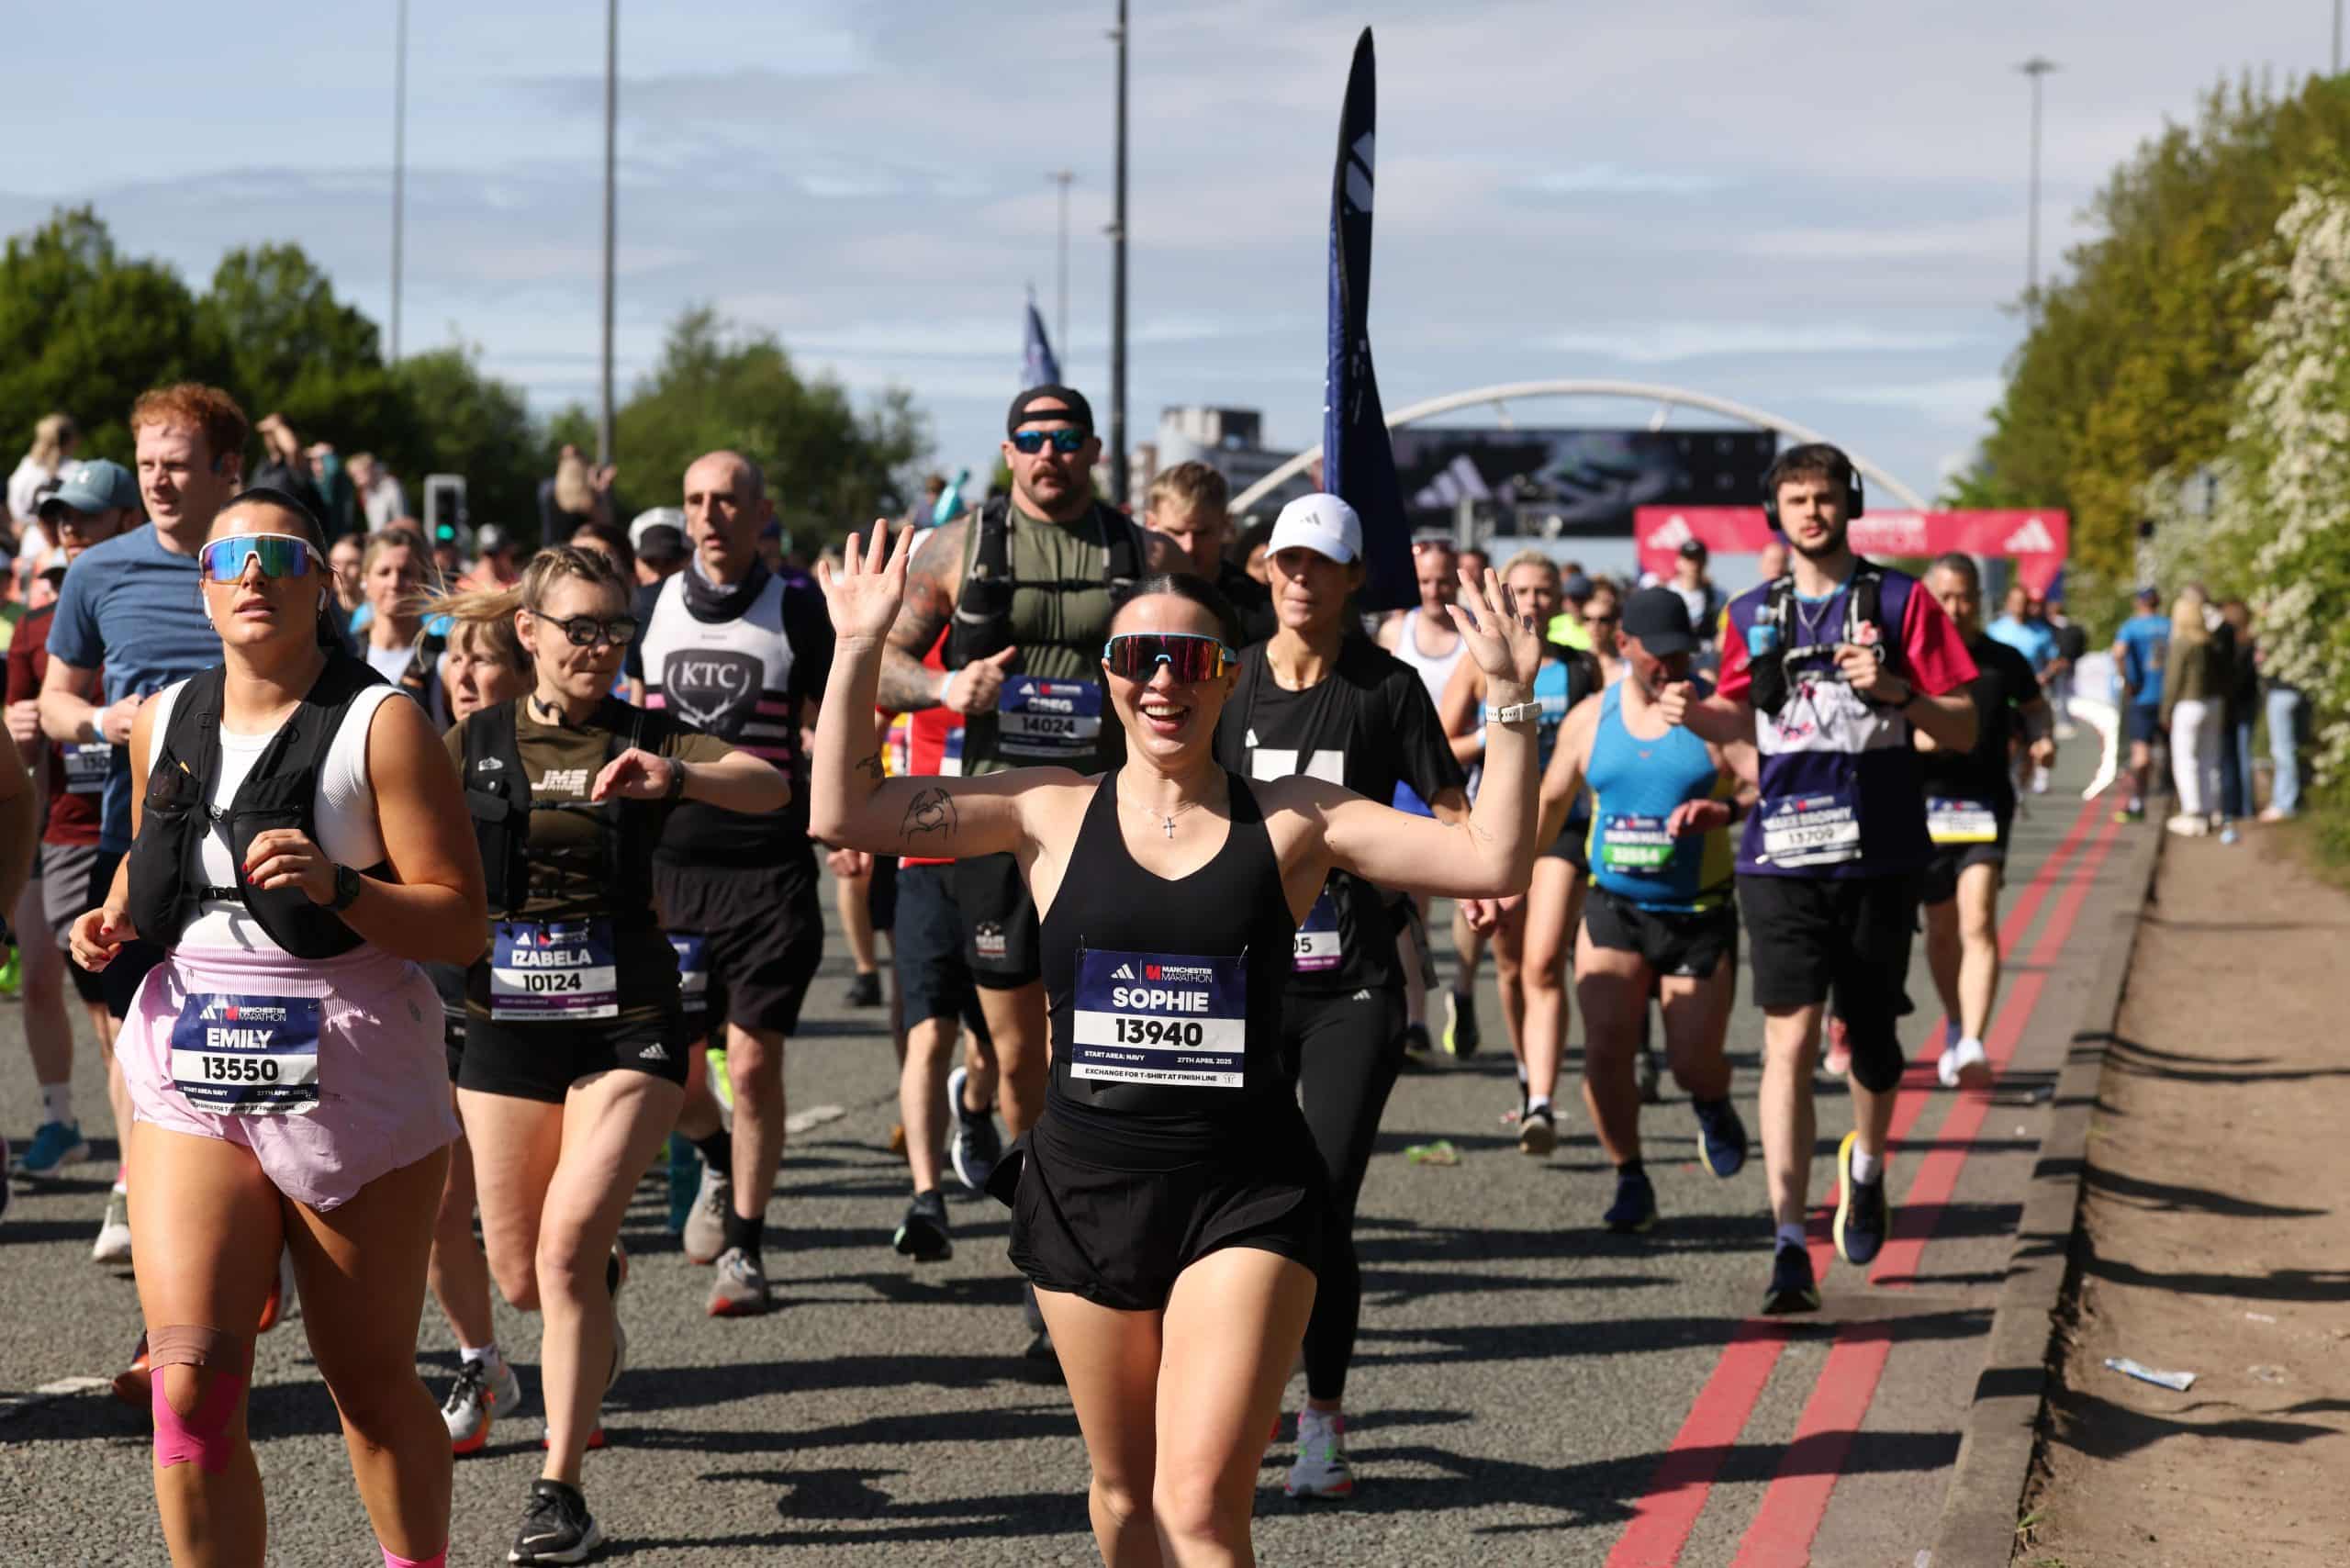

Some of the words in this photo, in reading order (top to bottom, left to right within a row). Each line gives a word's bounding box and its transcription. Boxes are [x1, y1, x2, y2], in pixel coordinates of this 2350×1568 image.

[681, 661, 738, 688] KTC
[1023, 717, 1075, 733] 14024
[511, 947, 592, 967] IZABELA
[1161, 973, 1212, 983] MARATHON
[1162, 967, 1212, 975] MANCHESTER
[523, 973, 581, 991] 10124
[1112, 987, 1209, 1012] SOPHIE
[240, 1013, 286, 1021] MARATHON
[207, 1027, 273, 1049] EMILY
[1116, 1018, 1203, 1047] 13940
[202, 1057, 279, 1081] 13550
[1085, 1068, 1125, 1077] EXCHANGE
[1139, 1071, 1167, 1081] T-SHIRT
